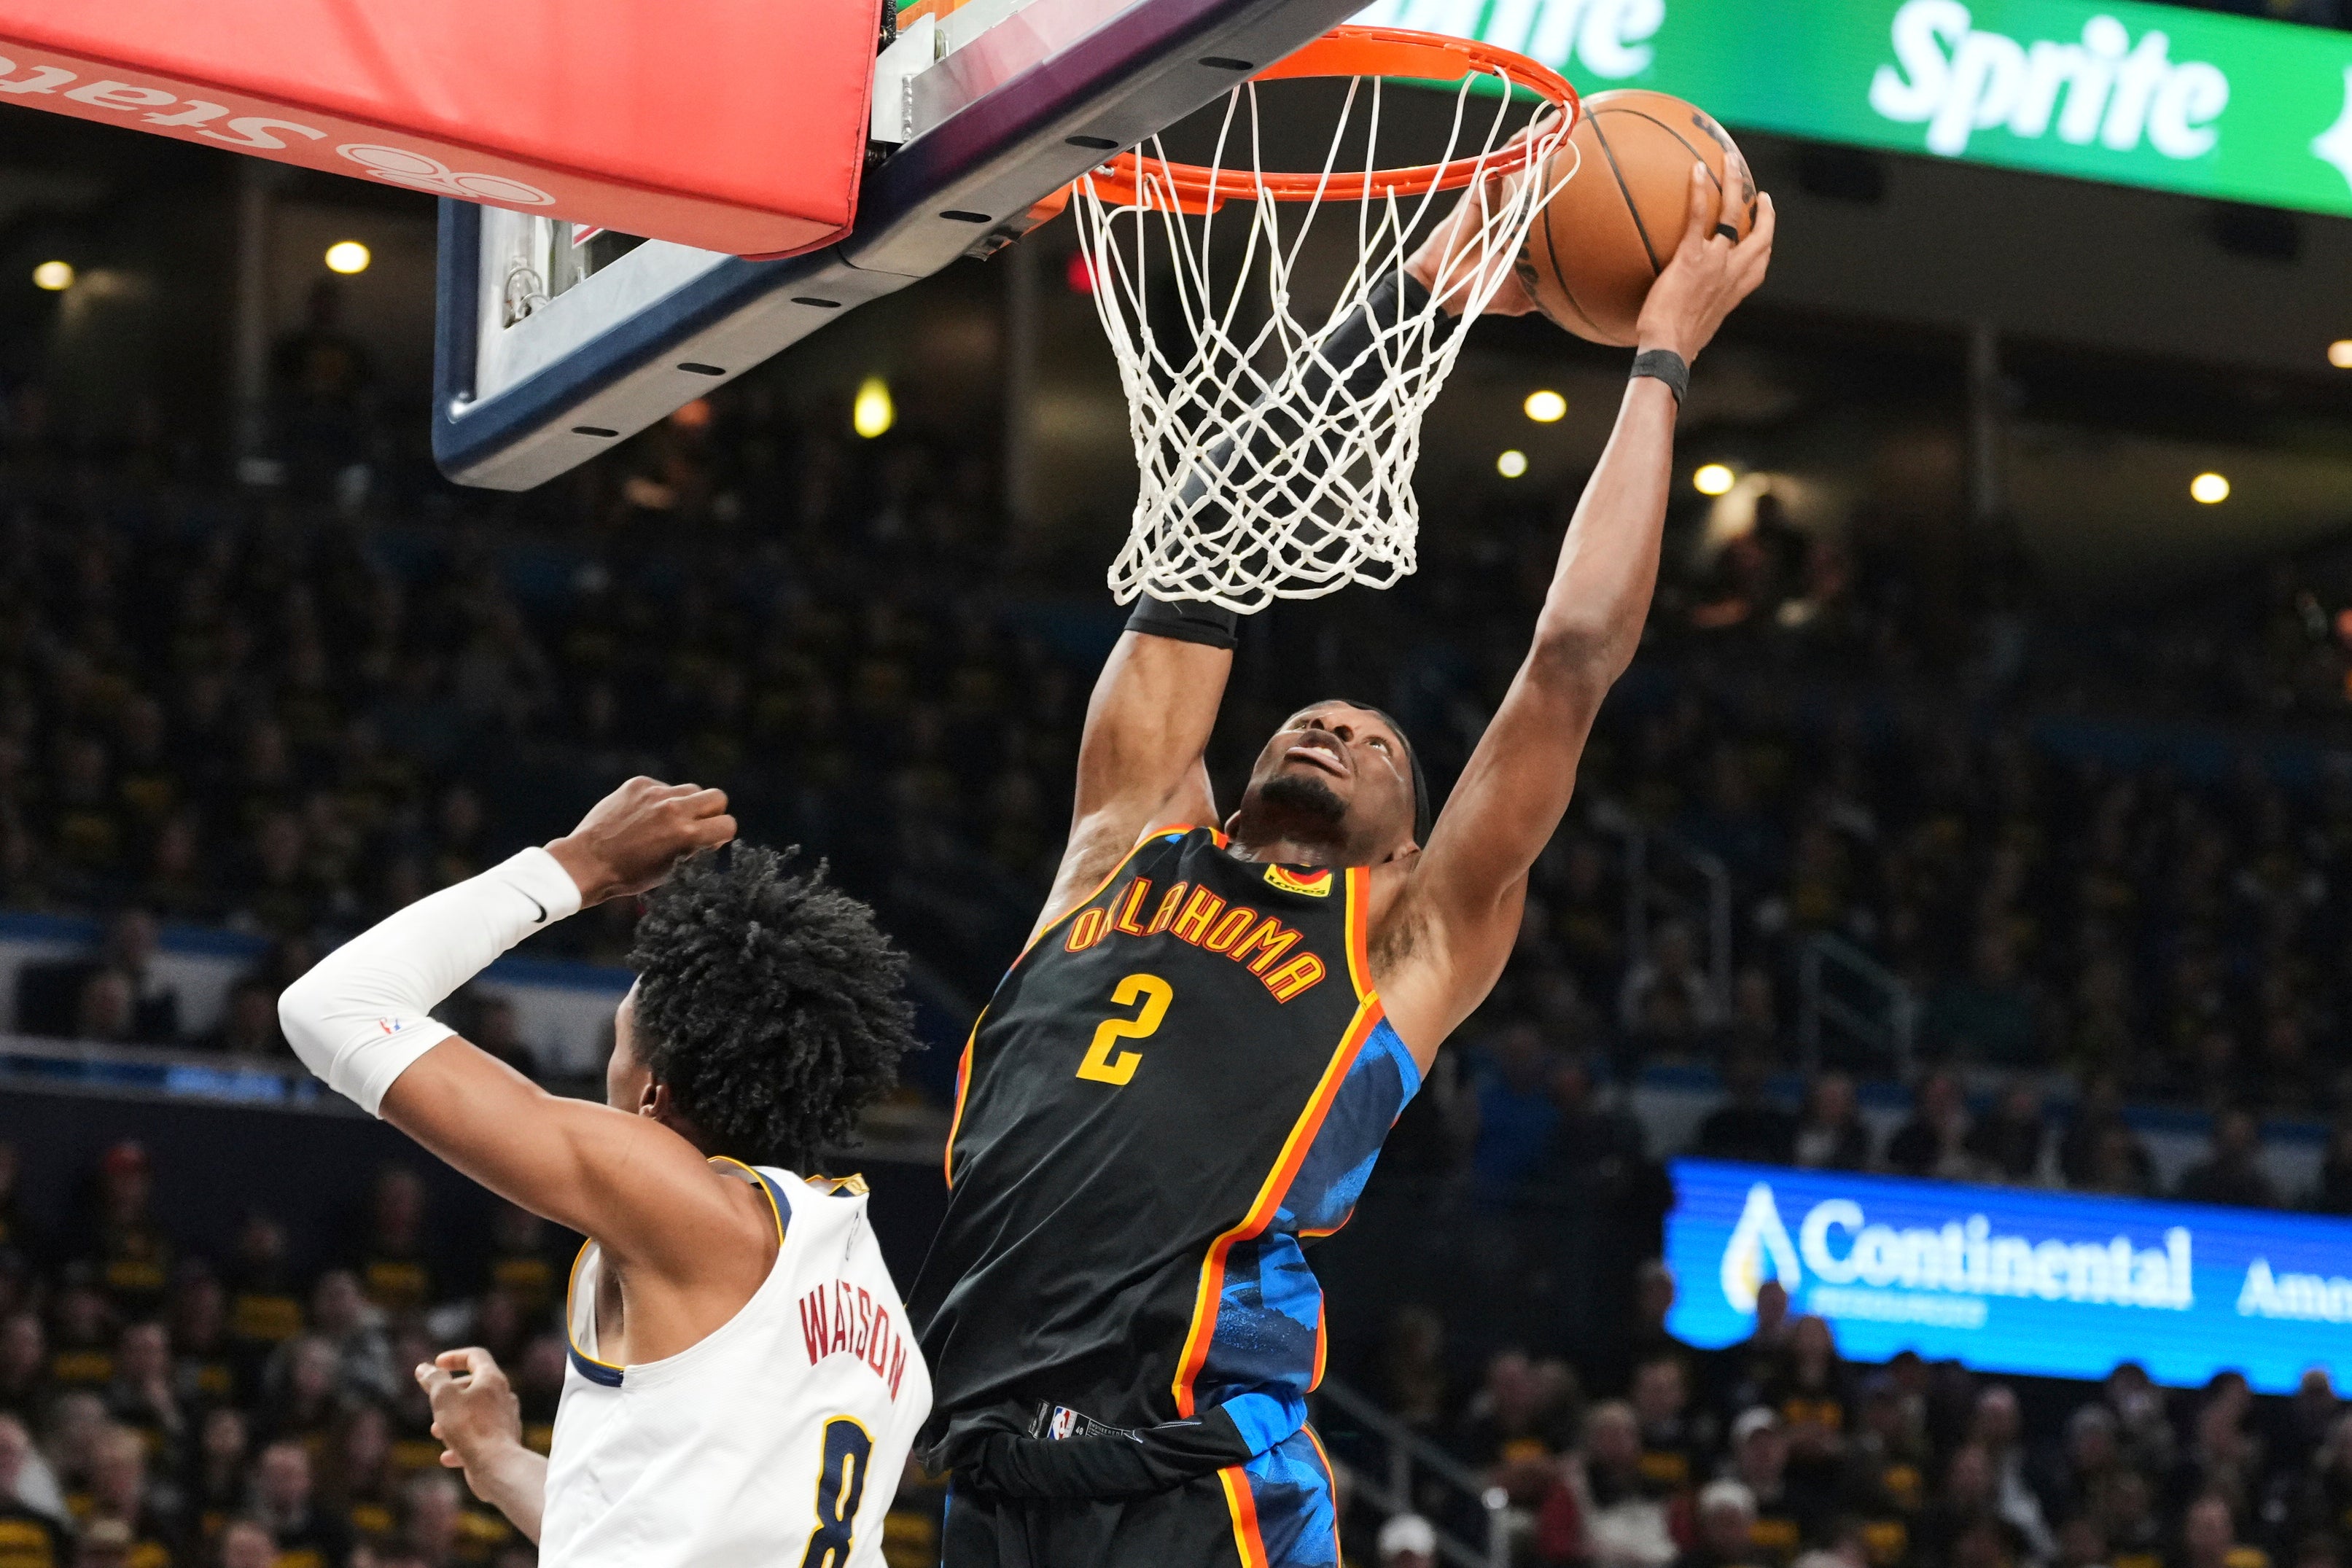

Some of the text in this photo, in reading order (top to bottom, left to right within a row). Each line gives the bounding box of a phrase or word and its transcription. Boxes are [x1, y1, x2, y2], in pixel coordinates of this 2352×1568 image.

[0, 55, 327, 149] Stat
[1869, 0, 2230, 158] Sprite
[1065, 876, 1326, 1004] OKLAHOMA
[1075, 973, 1173, 1085] 2
[1799, 1198, 2194, 1311] Continental
[799, 1279, 906, 1405] WATSON
[798, 1414, 875, 1568] 8
